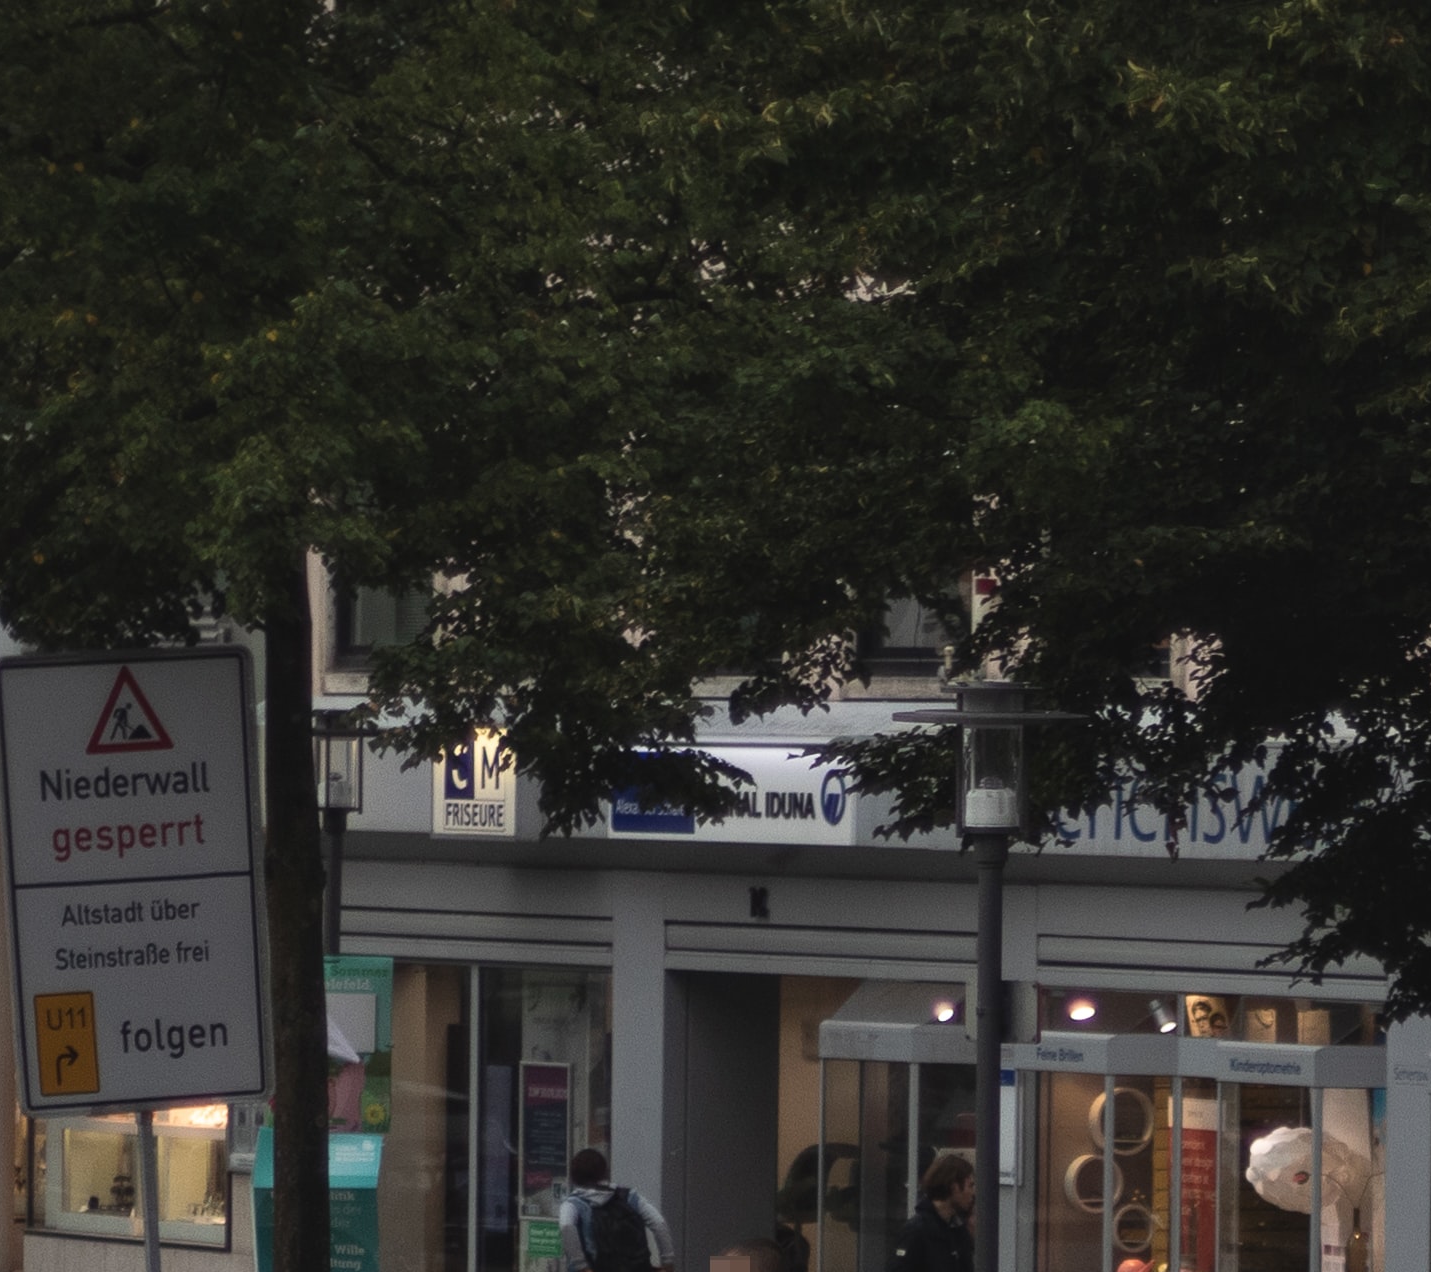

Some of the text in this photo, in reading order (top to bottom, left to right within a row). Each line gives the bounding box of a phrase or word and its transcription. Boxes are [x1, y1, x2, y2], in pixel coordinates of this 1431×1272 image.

[40, 761, 211, 801] Niederwall
[446, 803, 505, 828] FRISEURE
[765, 793, 816, 820] IDUNA
[52, 813, 206, 862] gesperrt
[61, 899, 201, 927] Altstadt über
[55, 940, 210, 971] Steinstraße frei
[46, 1007, 87, 1031] U11
[120, 1018, 229, 1059] folgen
